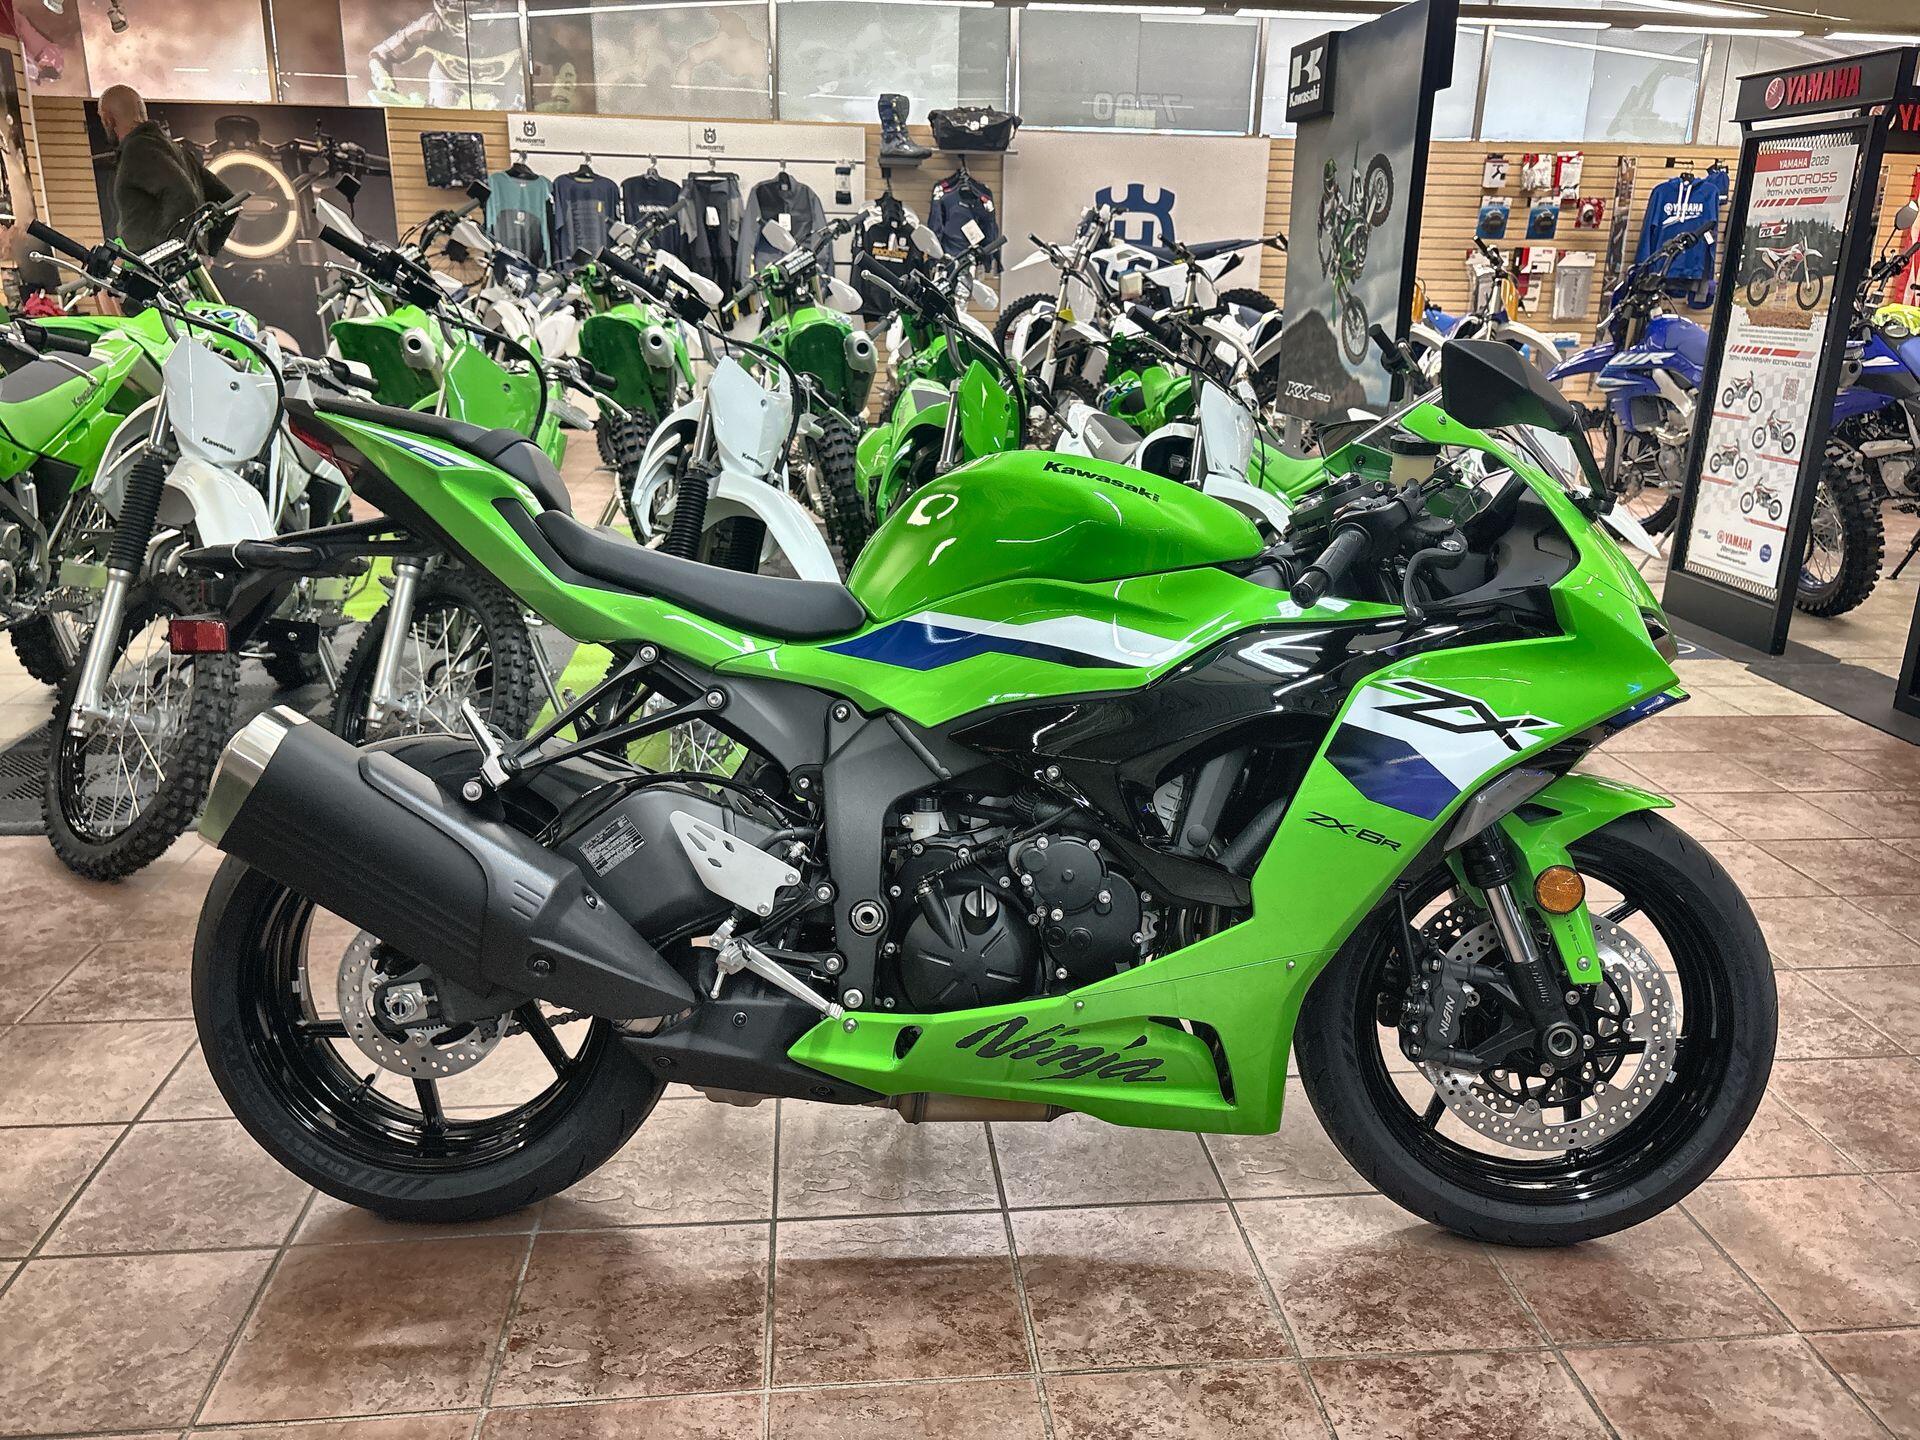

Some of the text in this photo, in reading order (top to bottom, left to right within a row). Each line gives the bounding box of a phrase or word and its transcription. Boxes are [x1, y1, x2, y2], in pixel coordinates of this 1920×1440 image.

[1786, 65, 1862, 106] YAMAHA
[1779, 155, 1830, 169] YAMAHA 2026
[1765, 171, 1839, 188] MOTOCROSS
[1783, 185, 1833, 196] ANNIVERSARY
[1608, 351, 1677, 366] WR
[1284, 380, 1331, 403] KX 450
[201, 436, 236, 455] Kawasaki
[1043, 461, 1160, 503] Kawasaki
[1725, 532, 1753, 551] YAMAHA
[1370, 680, 1550, 751] ZX
[1303, 811, 1402, 852] ZX-6R
[1438, 995, 1457, 1038] NISSIN
[955, 1015, 1167, 1083] Ninja
